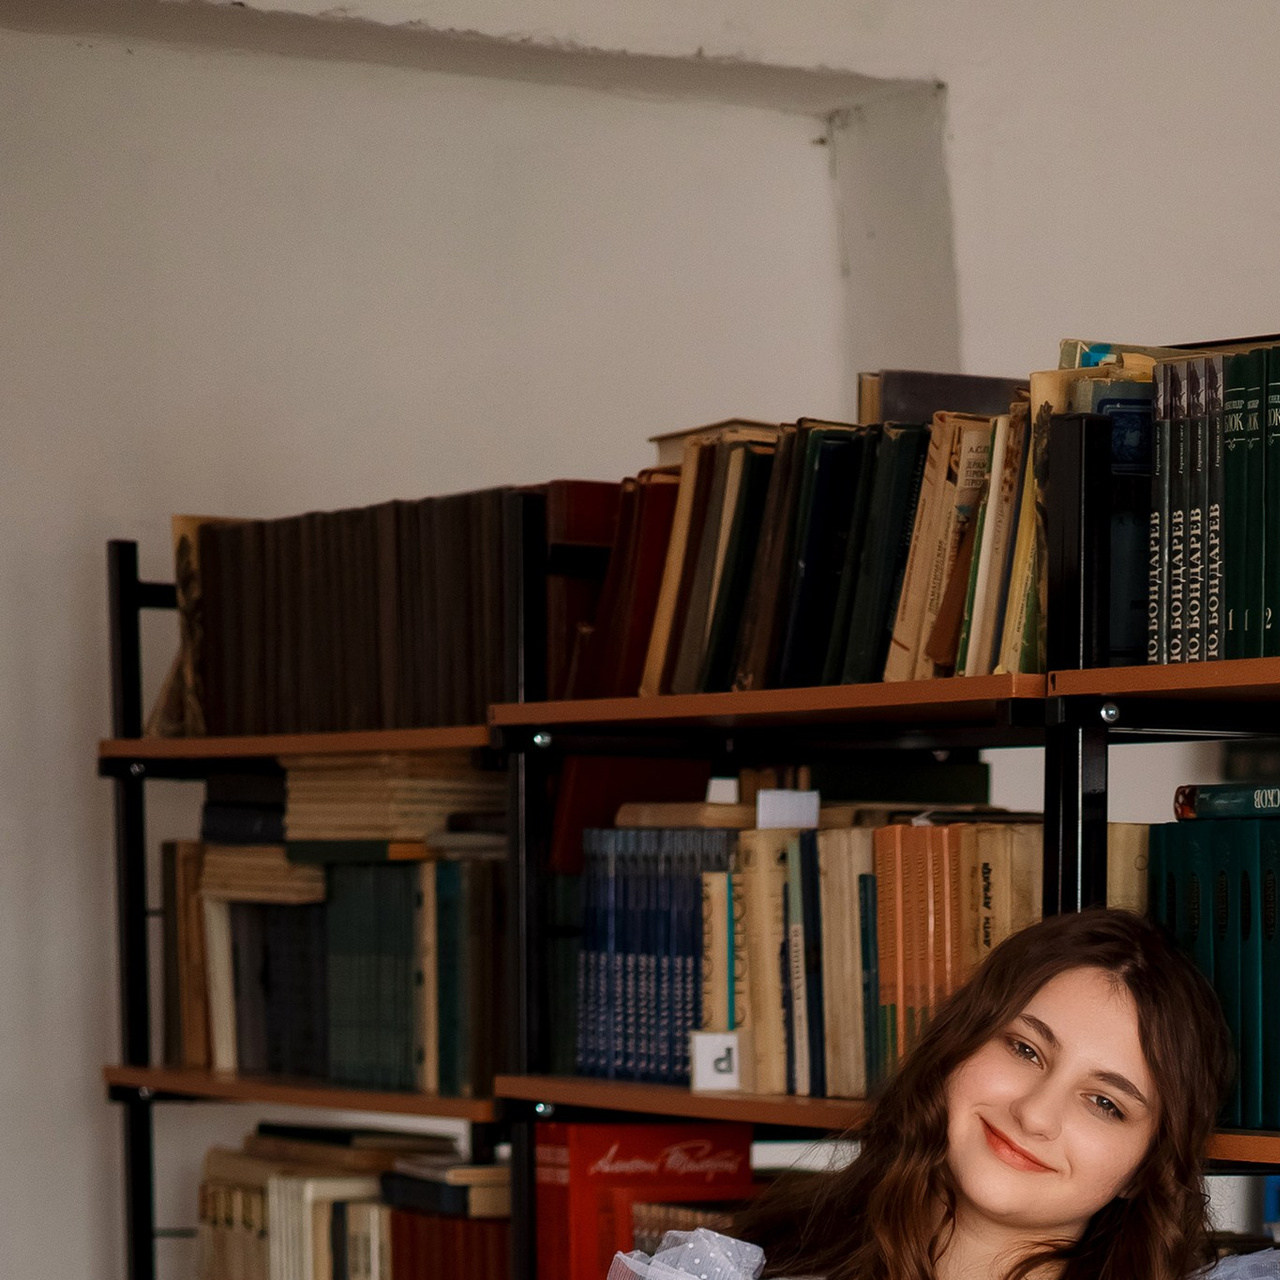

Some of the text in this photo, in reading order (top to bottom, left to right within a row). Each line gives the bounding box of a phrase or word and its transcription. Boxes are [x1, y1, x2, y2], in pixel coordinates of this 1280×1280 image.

[1148, 511, 1162, 662] Ю. БОНДАРЕВ
[1170, 509, 1186, 662] Ю. БОНДАРЕВ
[1188, 507, 1204, 662] Ю. БОНДАРЕВ
[1208, 503, 1222, 658] Ю. БОНДАРЕВ
[1266, 608, 1272, 629] 2
[713, 1047, 733, 1074] Р
